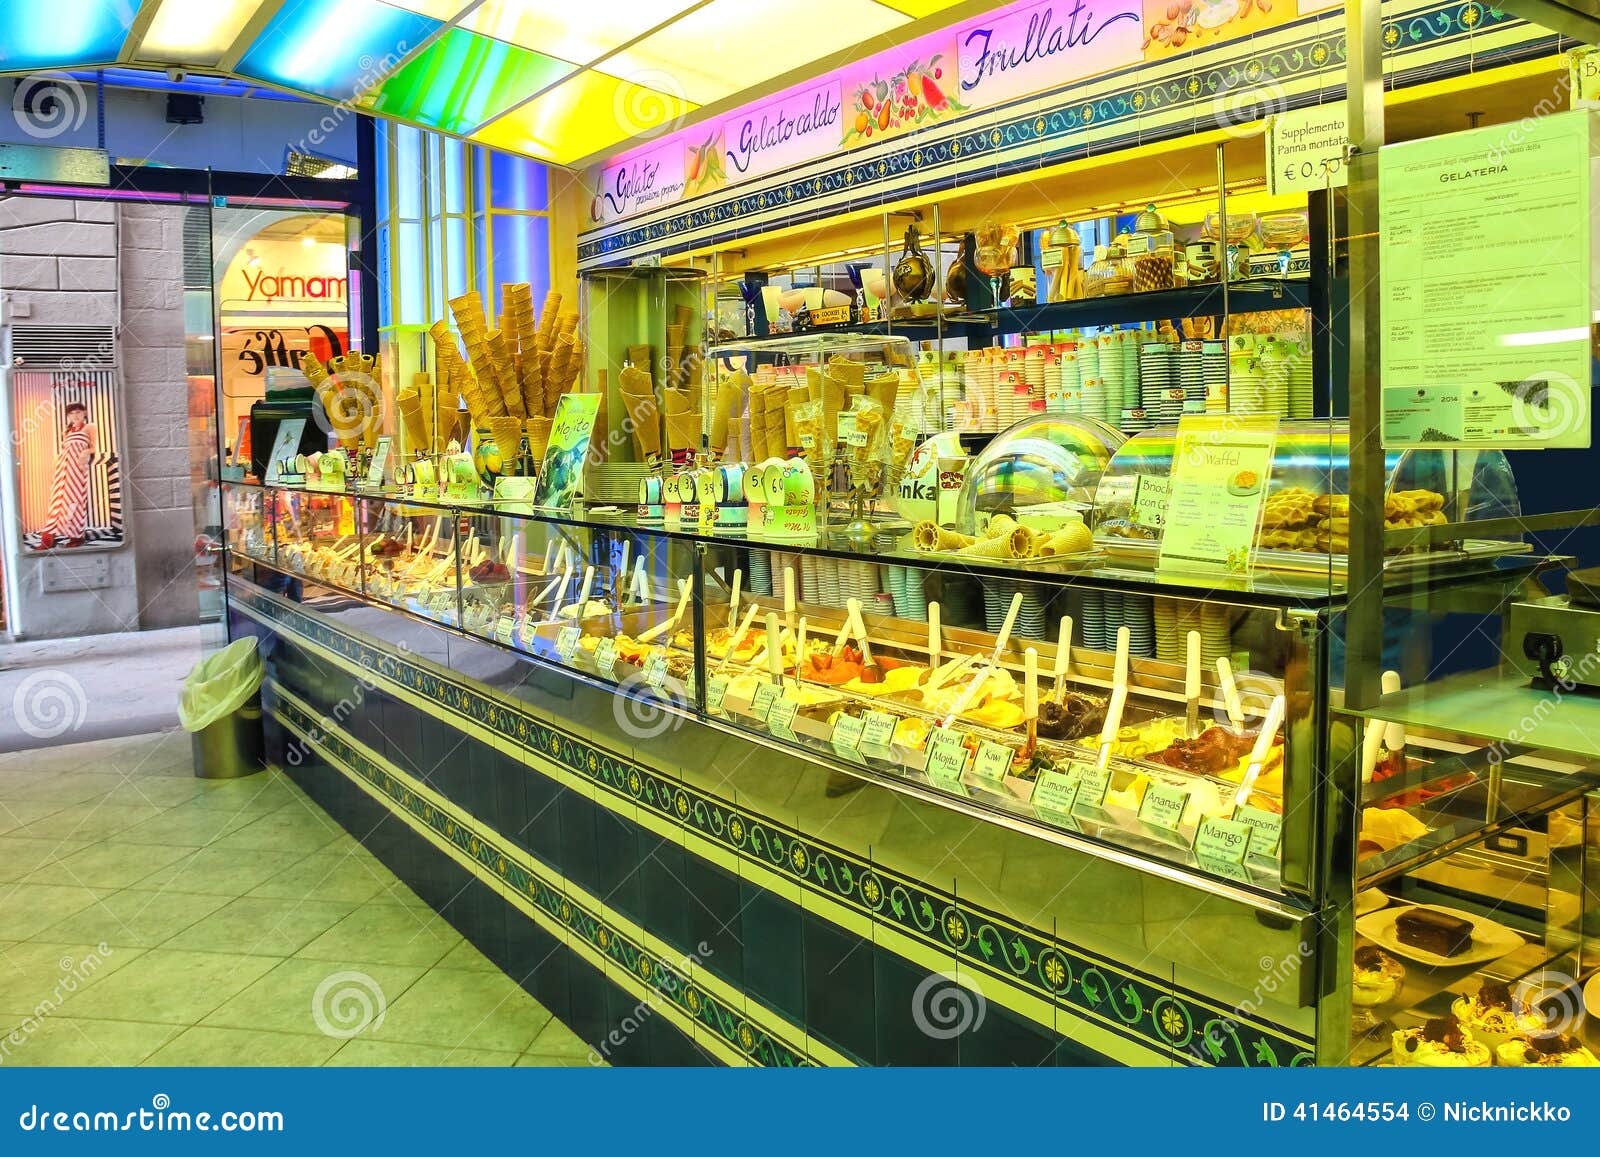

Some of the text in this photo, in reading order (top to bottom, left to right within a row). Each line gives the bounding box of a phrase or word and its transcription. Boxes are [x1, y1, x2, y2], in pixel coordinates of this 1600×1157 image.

[961, 0, 1140, 90] Frullati
[727, 90, 840, 172] Gelato caldo
[1281, 120, 1345, 143] Supplemento
[1278, 135, 1349, 155] Panna montata
[1284, 163, 1296, 180] €
[1439, 165, 1508, 183] GELATERIA
[605, 160, 659, 214] Gelato
[555, 417, 590, 440] Mojito
[1205, 450, 1241, 466] Waffel
[935, 733, 955, 746] Mora
[933, 751, 958, 770] Mojito
[984, 749, 1001, 763] Kiwi
[1041, 777, 1073, 795] Limone
[1147, 791, 1181, 810] Ananas
[1236, 812, 1279, 834] Lampone
[1203, 824, 1243, 847] Mango
